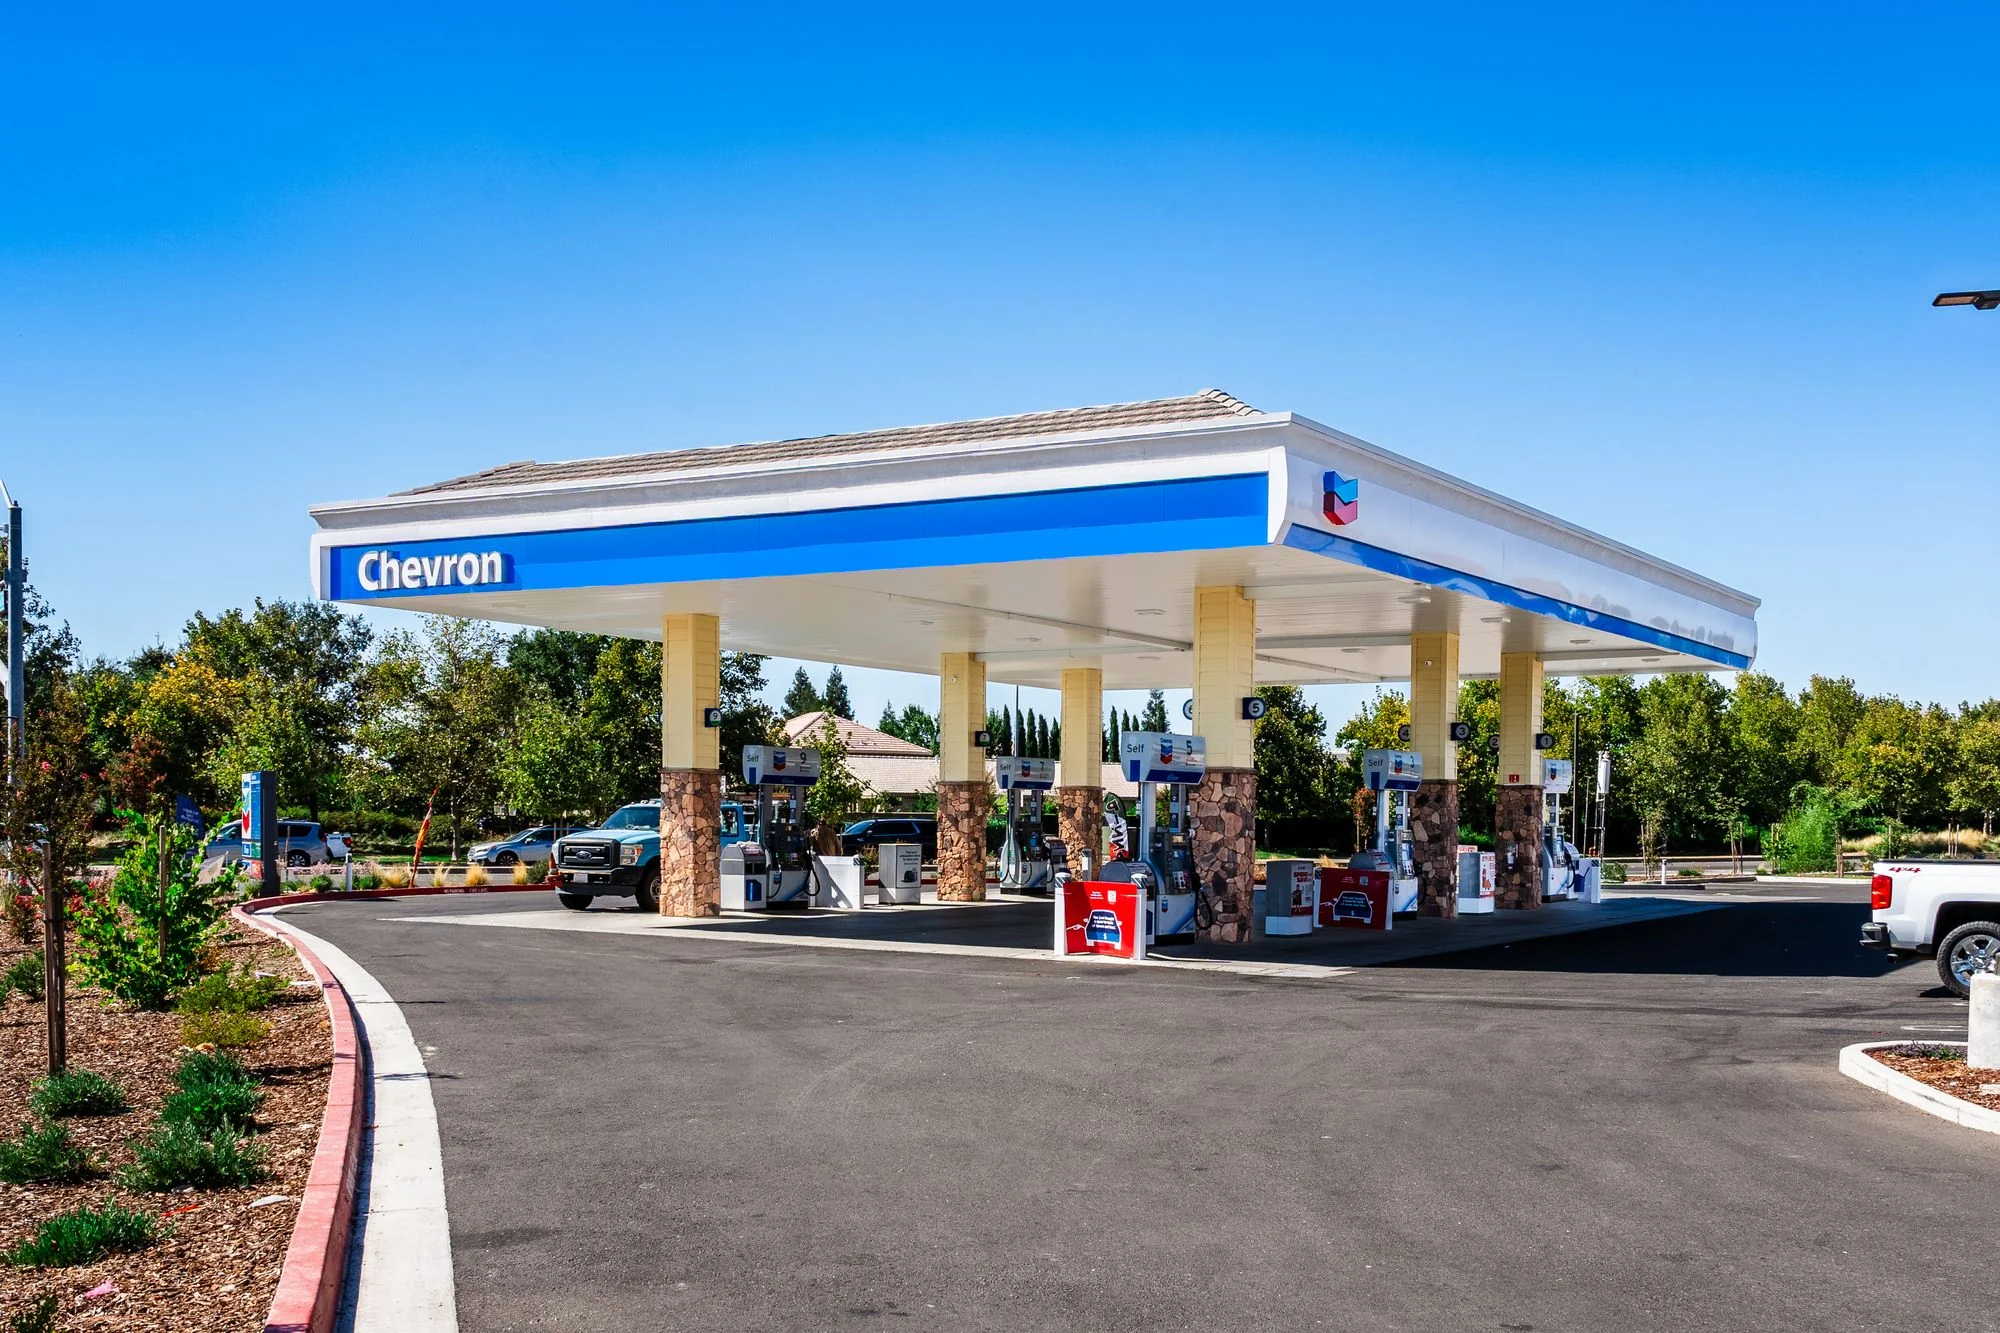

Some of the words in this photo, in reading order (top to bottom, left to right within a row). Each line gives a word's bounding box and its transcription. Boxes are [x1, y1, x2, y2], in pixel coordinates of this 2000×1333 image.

[358, 550, 502, 591] Chevron
[1252, 703, 1260, 714] 5
[1402, 729, 1410, 738] 4
[1126, 744, 1144, 753] Self
[1186, 740, 1193, 755] 5
[747, 754, 759, 762] Self
[800, 752, 807, 764] 9
[1368, 759, 1384, 767] Self
[1410, 755, 1415, 768] 3
